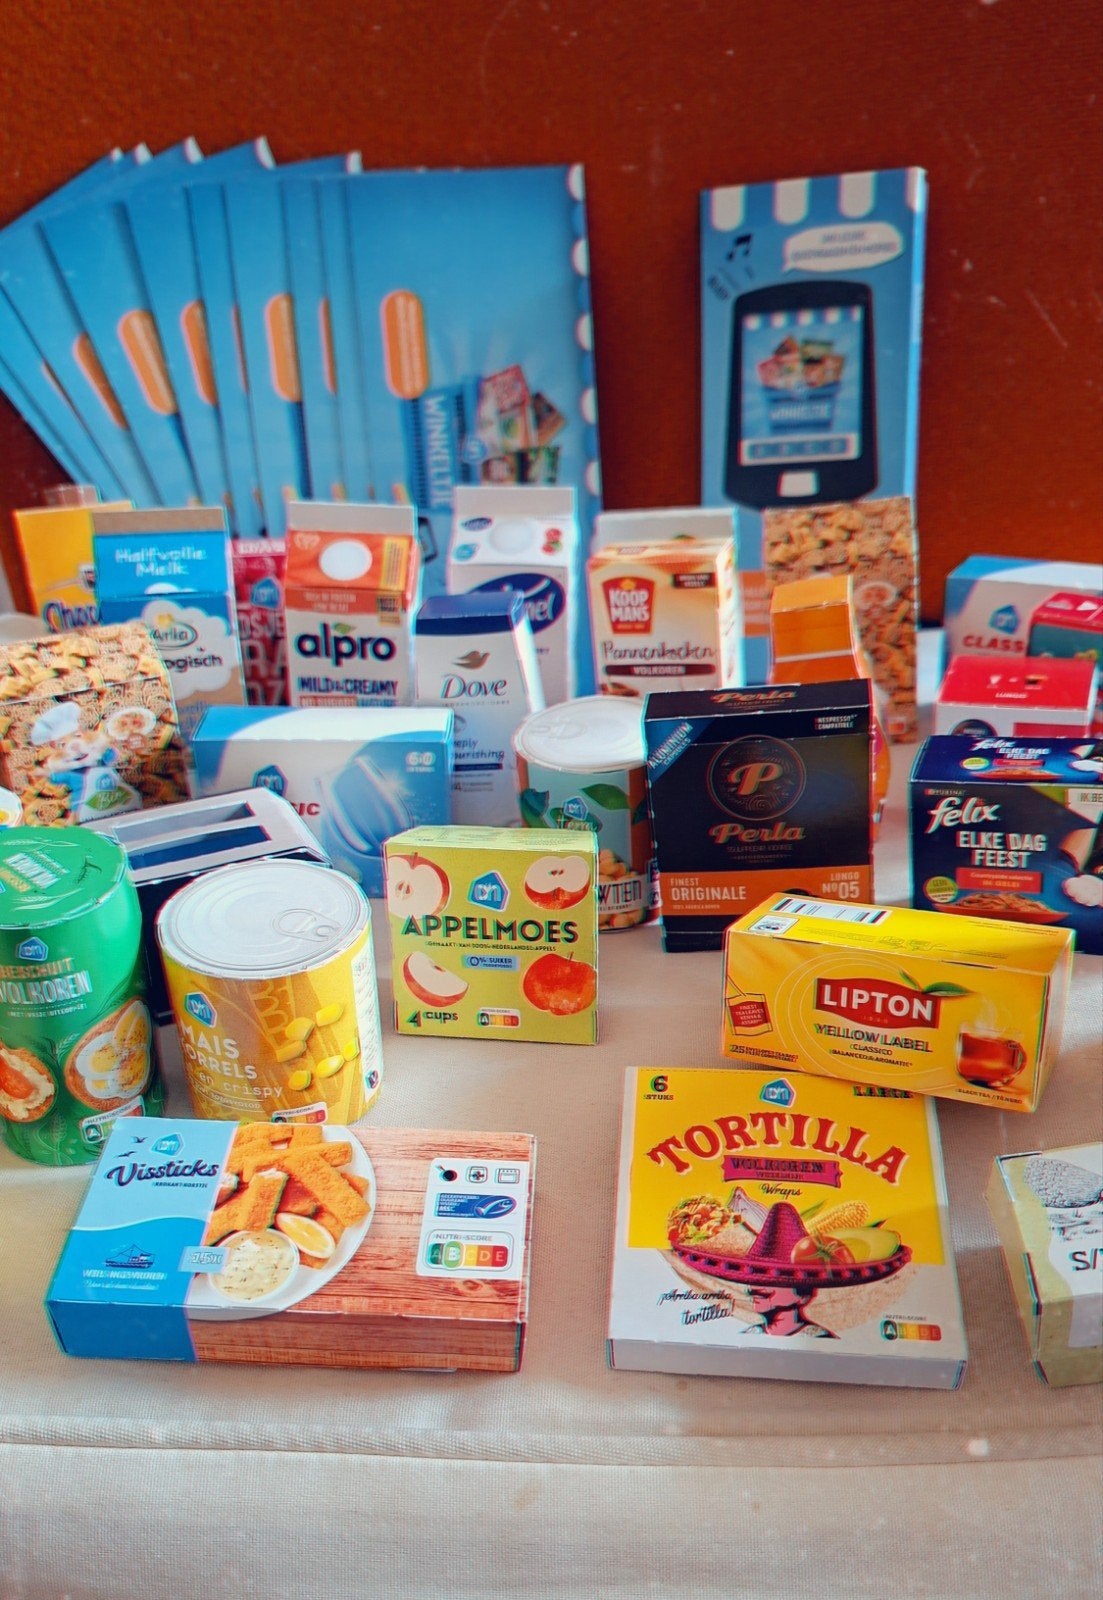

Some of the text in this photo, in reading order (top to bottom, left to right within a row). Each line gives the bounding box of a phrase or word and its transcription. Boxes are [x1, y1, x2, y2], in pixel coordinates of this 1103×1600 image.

[608, 587, 649, 606] KOOP
[610, 606, 650, 622] MANS
[294, 622, 397, 668] alpro
[441, 674, 508, 700] Dove
[710, 689, 797, 704] Perla
[646, 722, 693, 770] ALUMINIUM
[925, 797, 1001, 834] felix
[708, 822, 807, 844] Perla
[956, 831, 1047, 852] ELKE DAG
[971, 850, 1031, 868] FEEST
[670, 878, 700, 887] FINEST
[830, 871, 860, 881] LUNGO
[671, 886, 747, 901] ORIGINALE
[402, 914, 579, 944] APPELMOES
[823, 984, 933, 1022] LIPTON
[407, 1010, 459, 1028] 4 cups
[181, 1021, 240, 1060] MAIS
[814, 1023, 933, 1053] YELLOW LABEL
[183, 1040, 258, 1080] ORRELS
[223, 1082, 283, 1098] crispy
[650, 1075, 669, 1093] 6
[647, 1112, 909, 1186] TORTILLA
[107, 1159, 220, 1188] Vissticks
[730, 1158, 824, 1174] VOLKOREN
[761, 1182, 803, 1200] Wraps
[433, 1233, 494, 1242] NUTRI-SCORE
